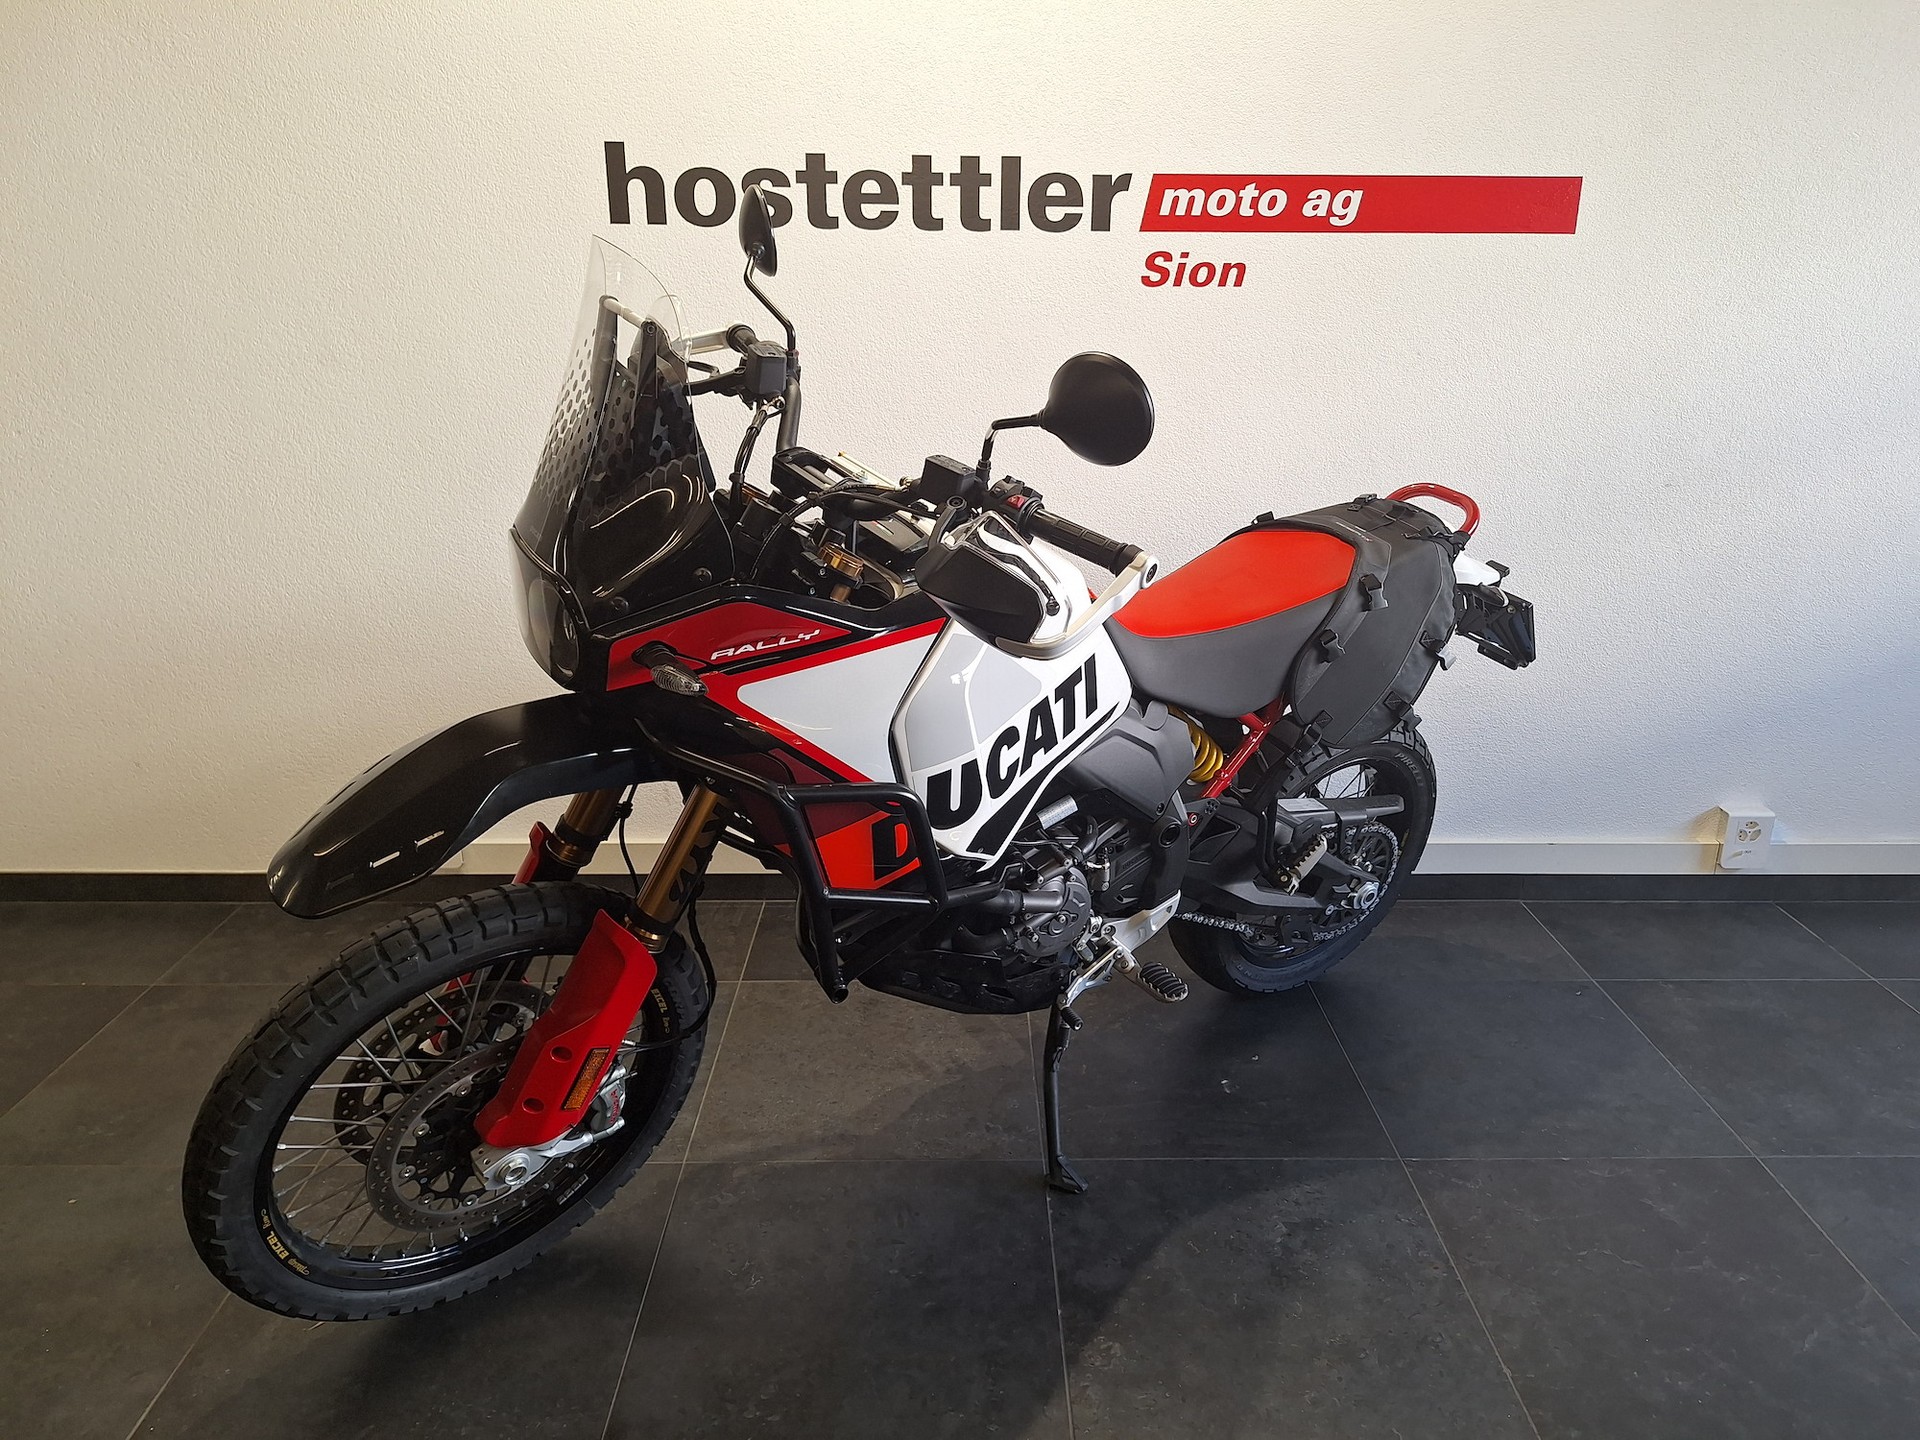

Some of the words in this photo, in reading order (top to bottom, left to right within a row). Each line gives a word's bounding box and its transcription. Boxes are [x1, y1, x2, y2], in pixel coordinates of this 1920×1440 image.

[603, 141, 1133, 233] hostettler
[1159, 182, 1288, 217] moto
[1301, 188, 1364, 227] ag
[1140, 251, 1247, 287] Sion
[710, 629, 821, 661] RALLY
[266, 1230, 290, 1260] EXCEL
